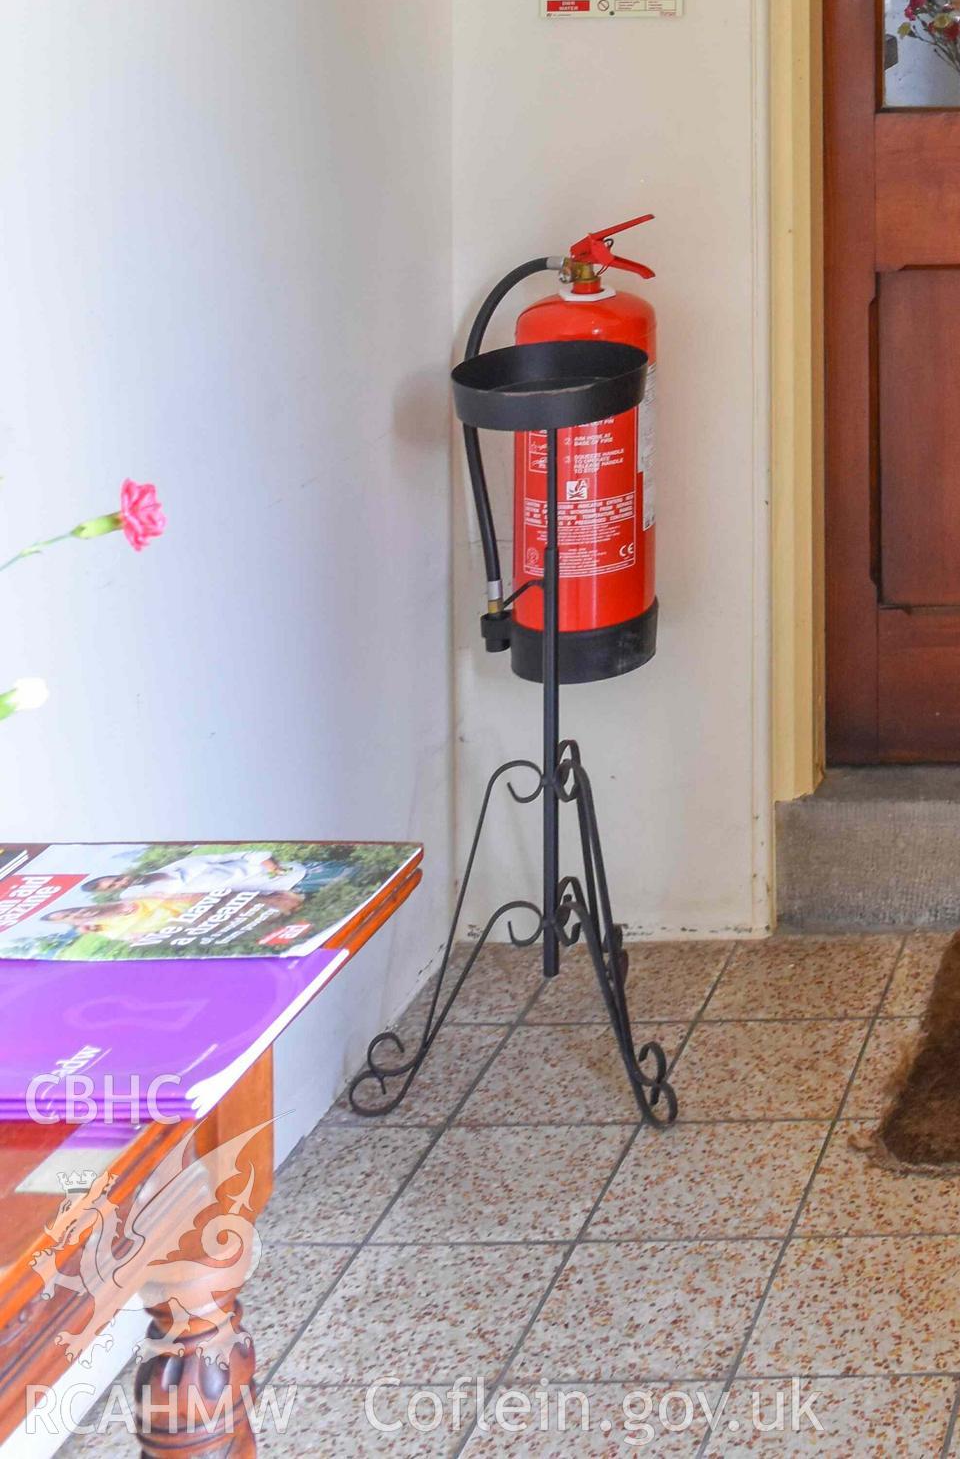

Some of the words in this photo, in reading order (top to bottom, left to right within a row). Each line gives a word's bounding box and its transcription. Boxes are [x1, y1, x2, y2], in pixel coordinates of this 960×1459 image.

[130, 926, 184, 947] We
[167, 887, 233, 923] have
[170, 936, 196, 946] a
[185, 891, 261, 935] dream
